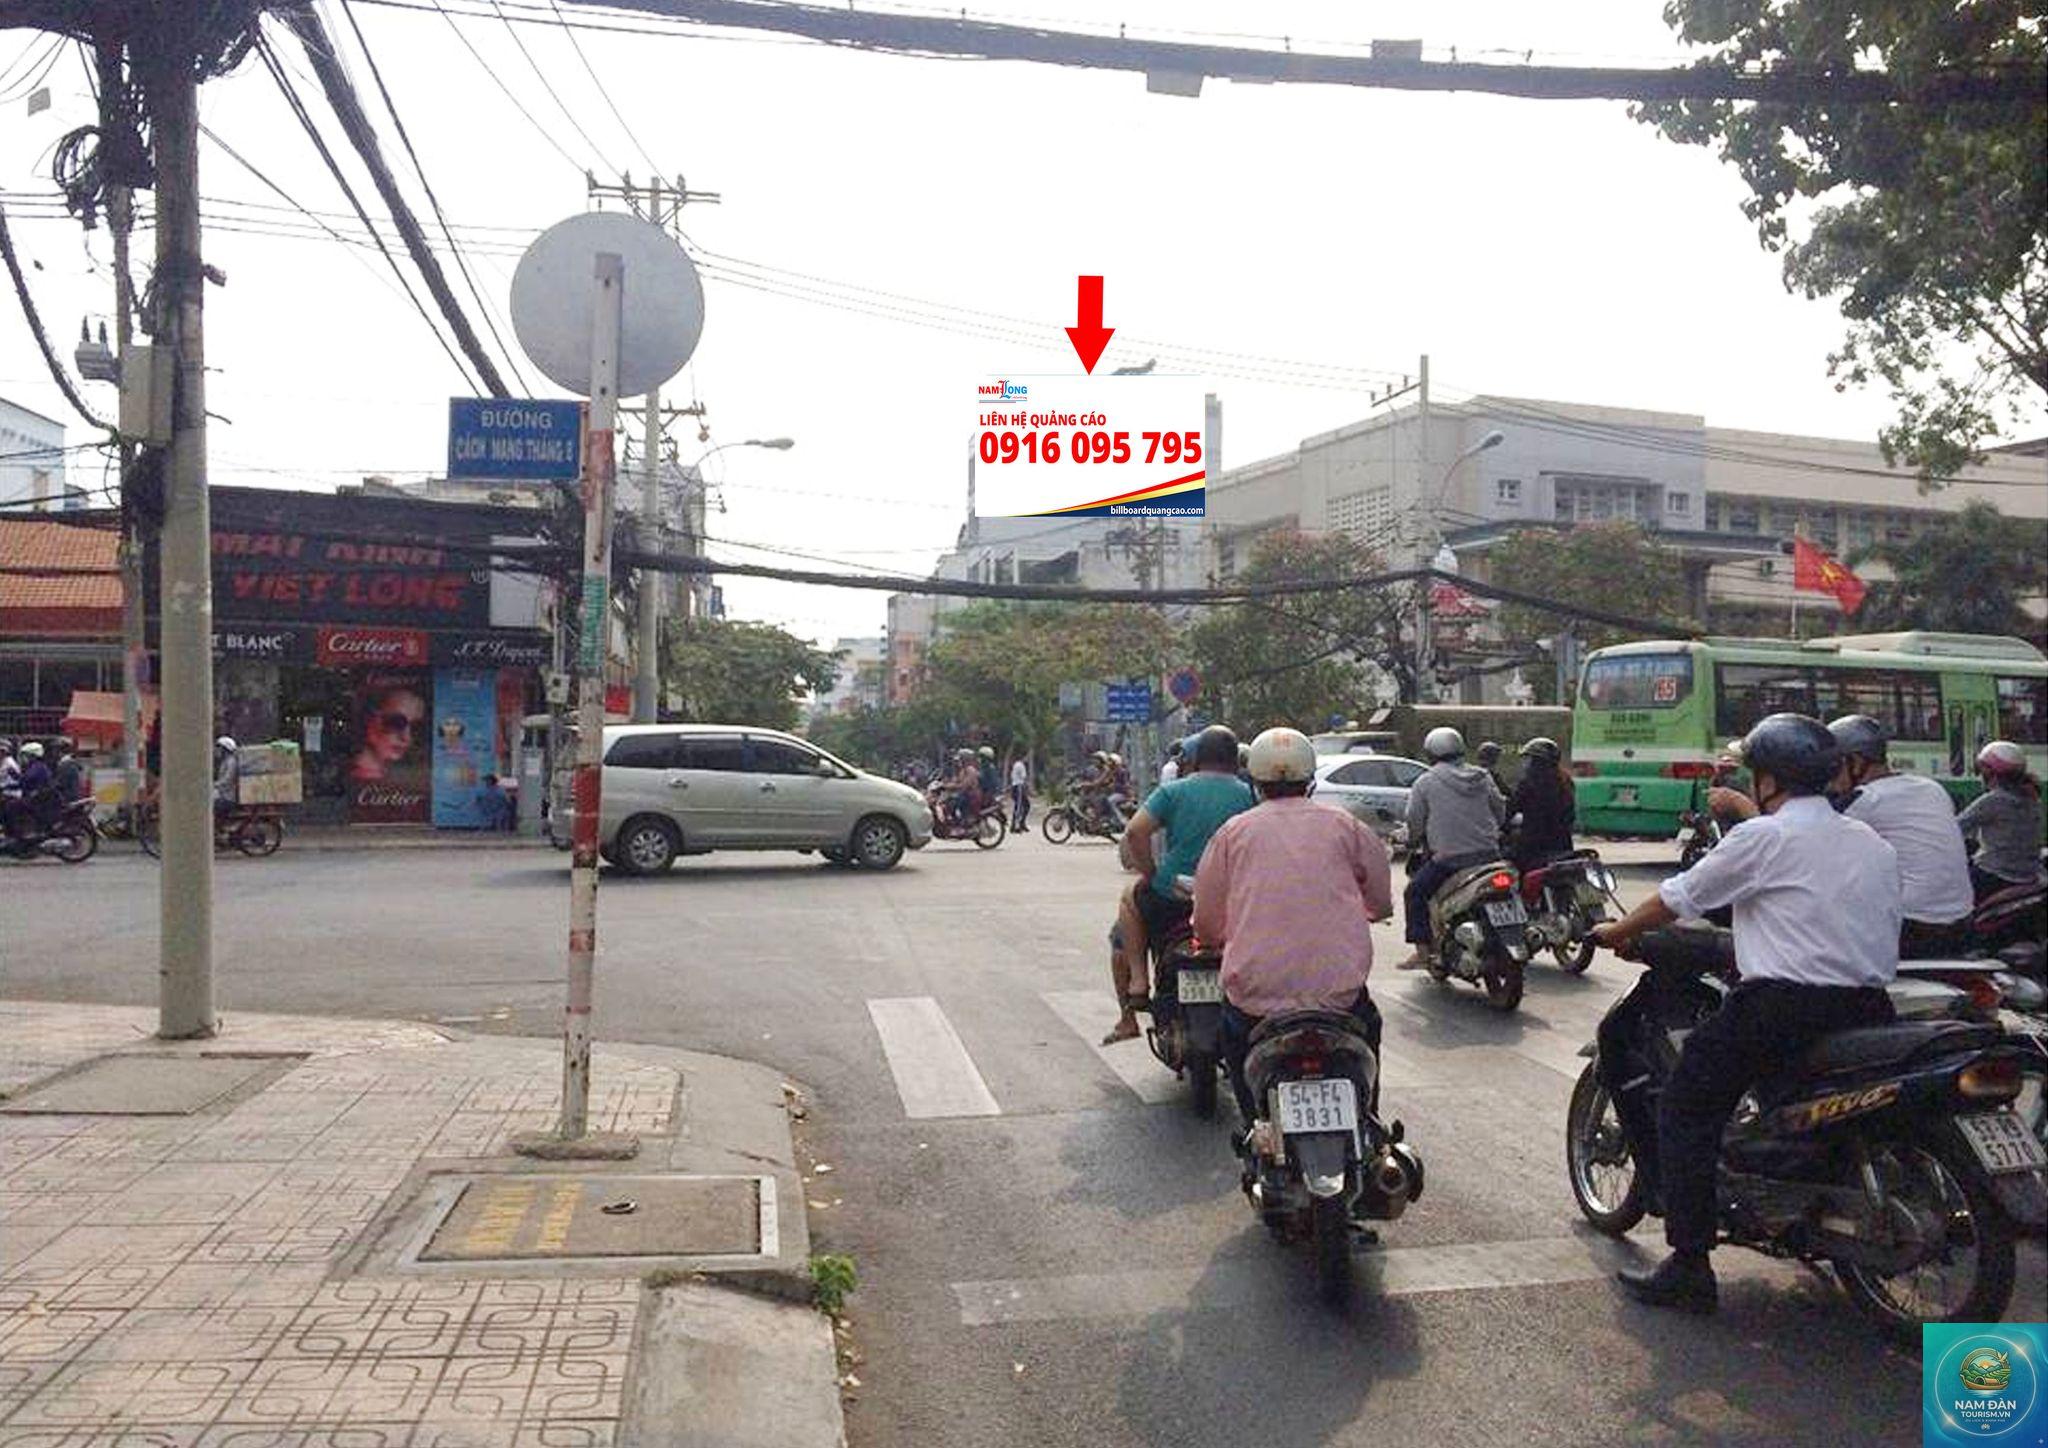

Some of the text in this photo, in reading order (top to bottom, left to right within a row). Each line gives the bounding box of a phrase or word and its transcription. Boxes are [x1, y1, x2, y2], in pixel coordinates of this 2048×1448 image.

[481, 408, 552, 428] ĐƯỜNG
[227, 634, 284, 650] BLANC
[327, 633, 402, 653] Cartier
[1292, 1107, 1342, 1127] 3831
